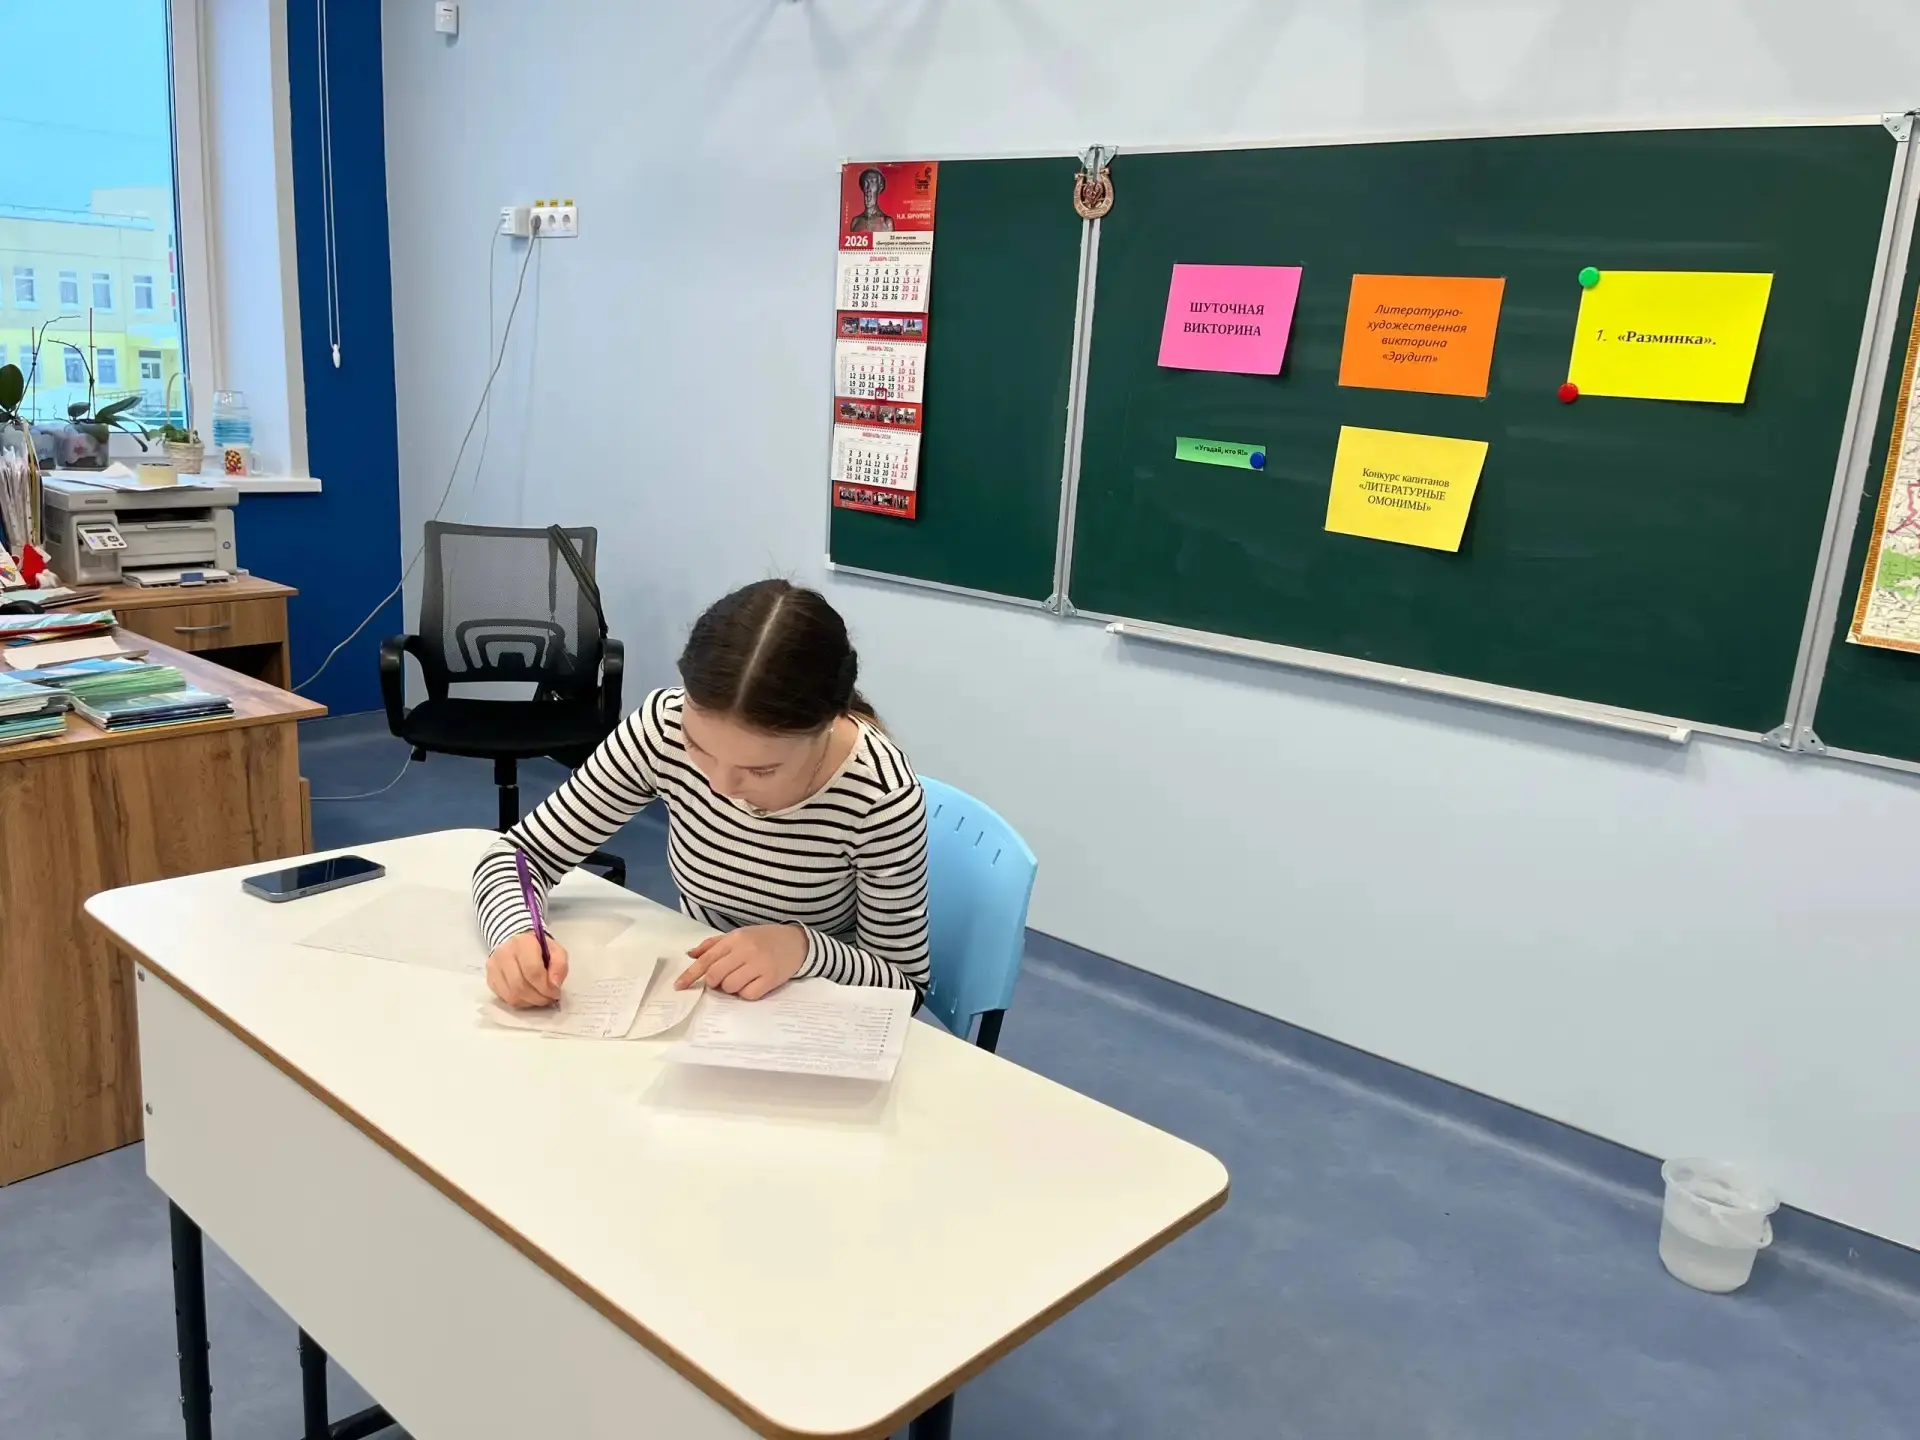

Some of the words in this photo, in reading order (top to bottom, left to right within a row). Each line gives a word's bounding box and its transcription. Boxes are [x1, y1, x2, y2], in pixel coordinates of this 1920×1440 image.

[845, 236, 868, 246] 2026
[1190, 302, 1264, 315] ШУТОЧНАЯ
[1375, 304, 1463, 318] Литературно-
[1184, 322, 1261, 336] ВИКТОРИНА
[1367, 320, 1468, 333] художественная
[1381, 338, 1447, 348] викторина
[1597, 329, 1607, 341] 1.
[1618, 330, 1716, 345] «Разминка».
[1383, 351, 1438, 363] «Эрудит»
[1195, 445, 1223, 454] «Угадай,
[1362, 468, 1400, 481] Конкурс
[1402, 475, 1450, 487] капитанов
[1359, 481, 1446, 501] «ЛИТЕРАТУРНЫЕ
[1368, 495, 1431, 512] ОМОНИМЫ»
